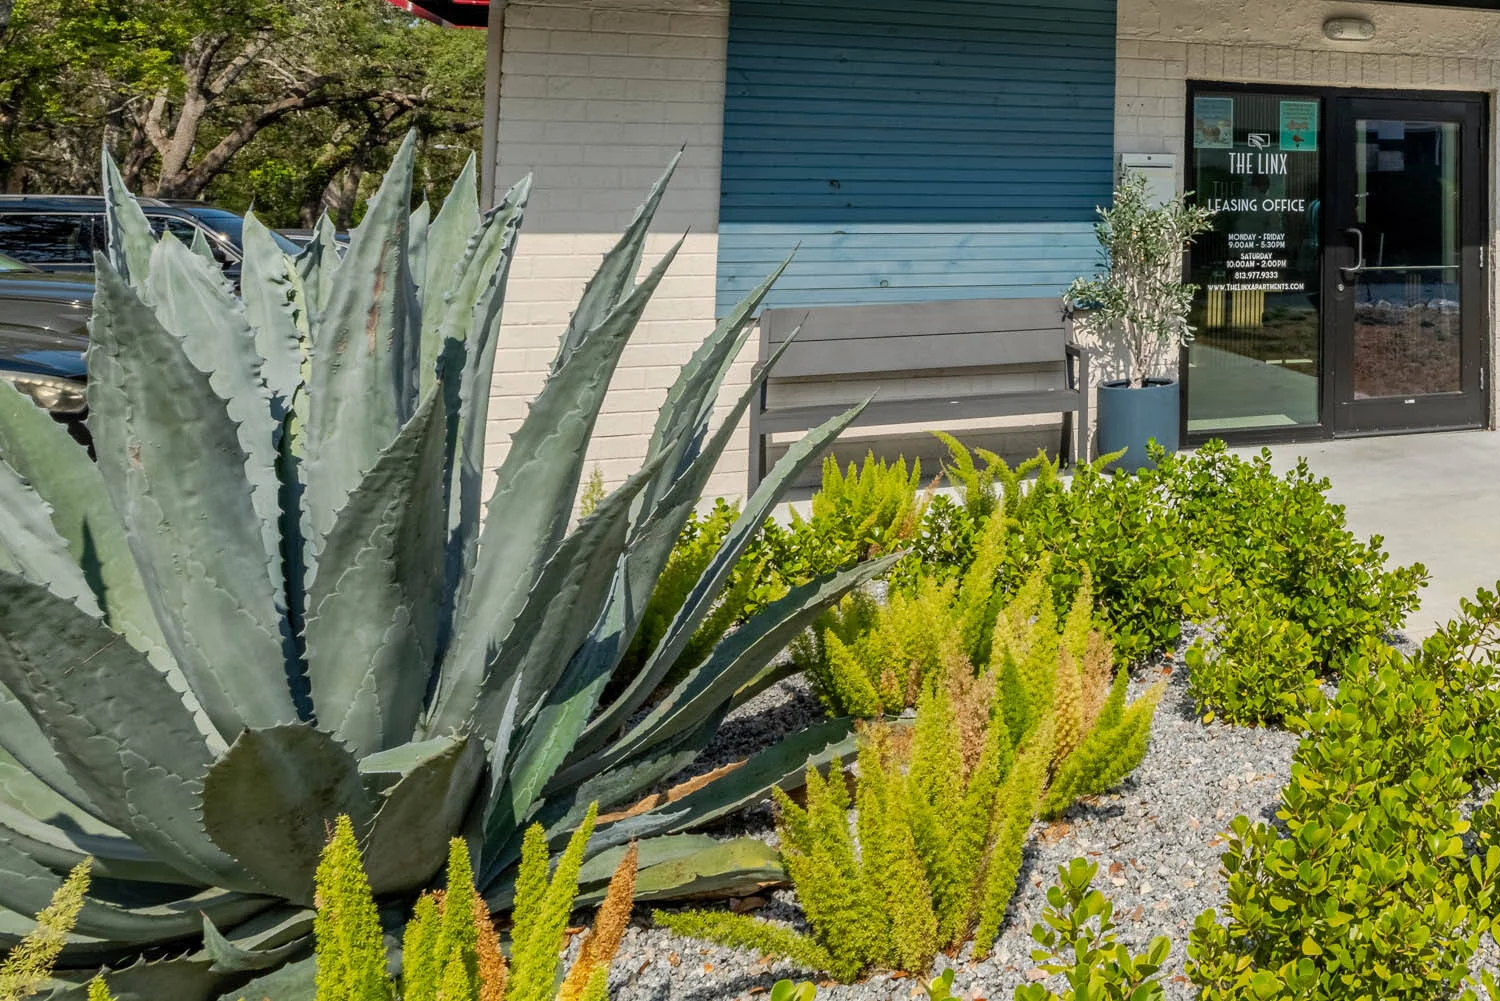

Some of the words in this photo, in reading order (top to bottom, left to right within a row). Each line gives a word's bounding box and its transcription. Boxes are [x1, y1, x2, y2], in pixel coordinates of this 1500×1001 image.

[1229, 152, 1253, 174] THE
[1258, 153, 1287, 174] LINX
[1207, 198, 1258, 212] LEASING
[1262, 199, 1305, 212] OFFICE
[1228, 233, 1257, 241] MONDAY
[1263, 233, 1286, 241] FRIDAY
[1240, 252, 1273, 260] SATURDAY
[1234, 271, 1279, 279] 813.977.9333
